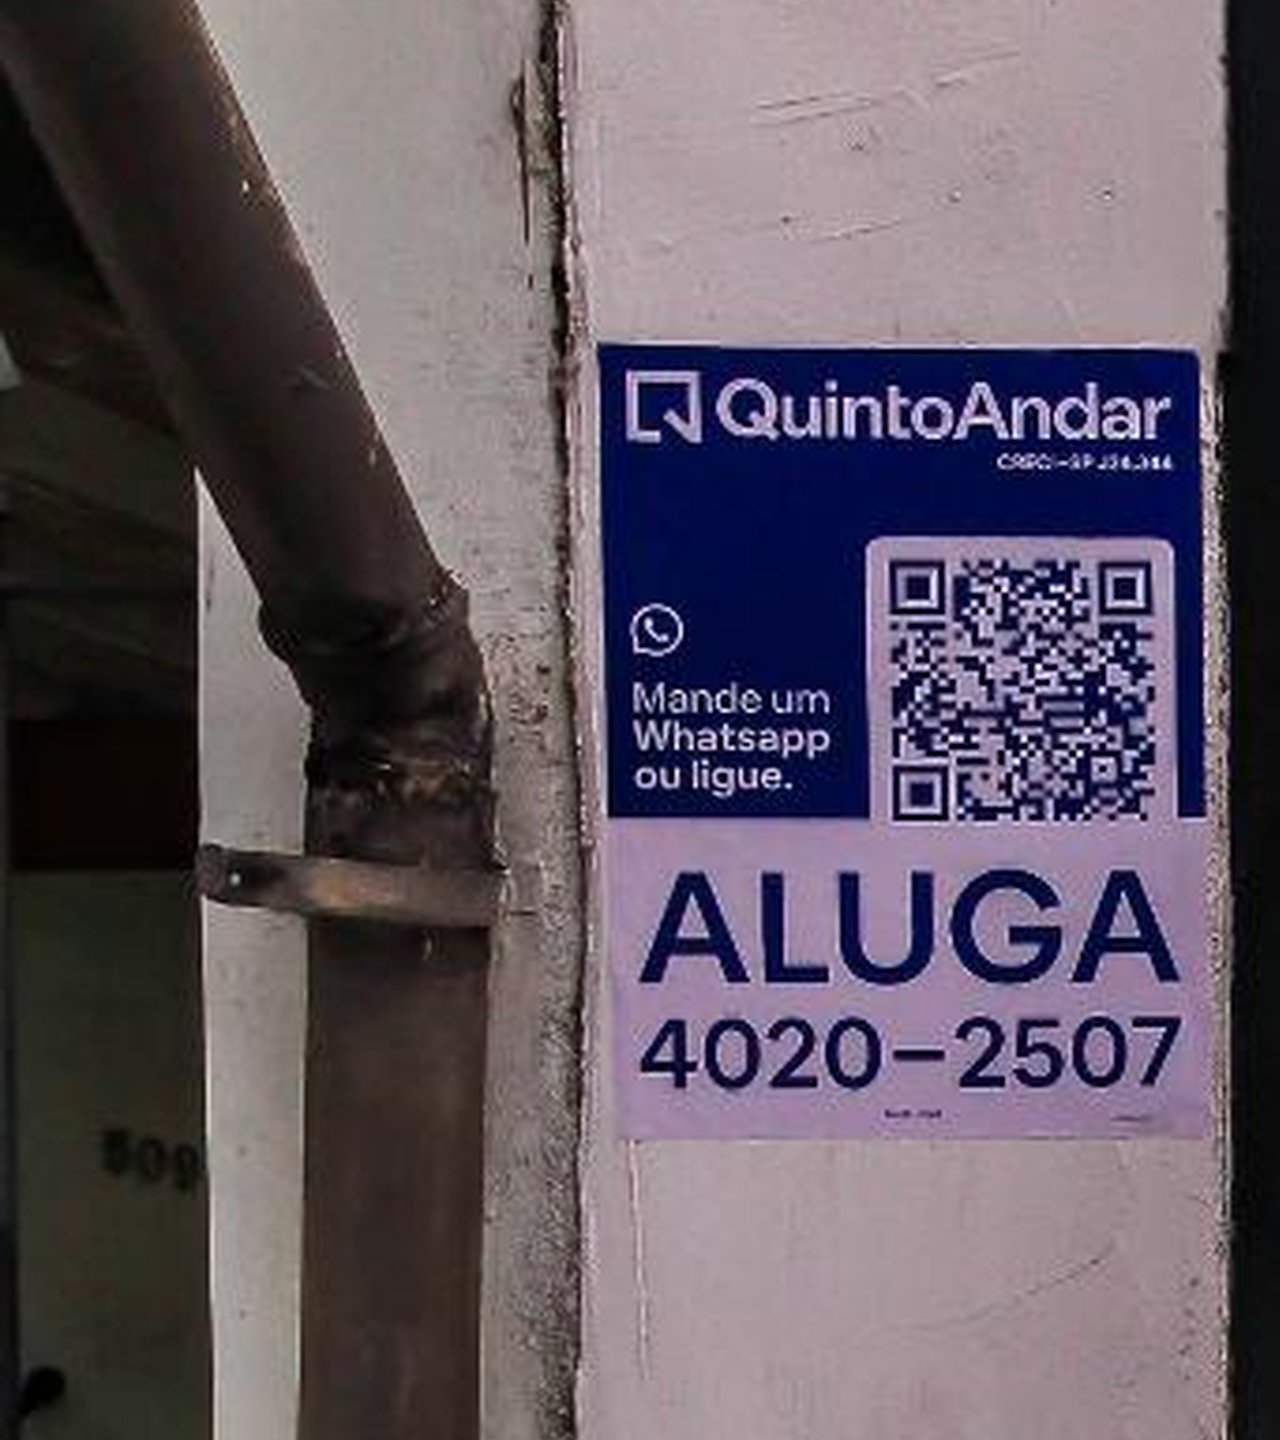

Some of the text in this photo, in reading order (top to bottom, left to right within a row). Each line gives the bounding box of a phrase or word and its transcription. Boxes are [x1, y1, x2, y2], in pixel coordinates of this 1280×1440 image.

[716, 376, 1173, 441] QuintoAndar
[632, 681, 830, 714] Mande um
[632, 719, 831, 759] Whatsapp
[634, 759, 794, 799] ou ligue.
[638, 868, 1182, 985] ALUGA
[639, 1015, 1183, 1090] 4020-2507
